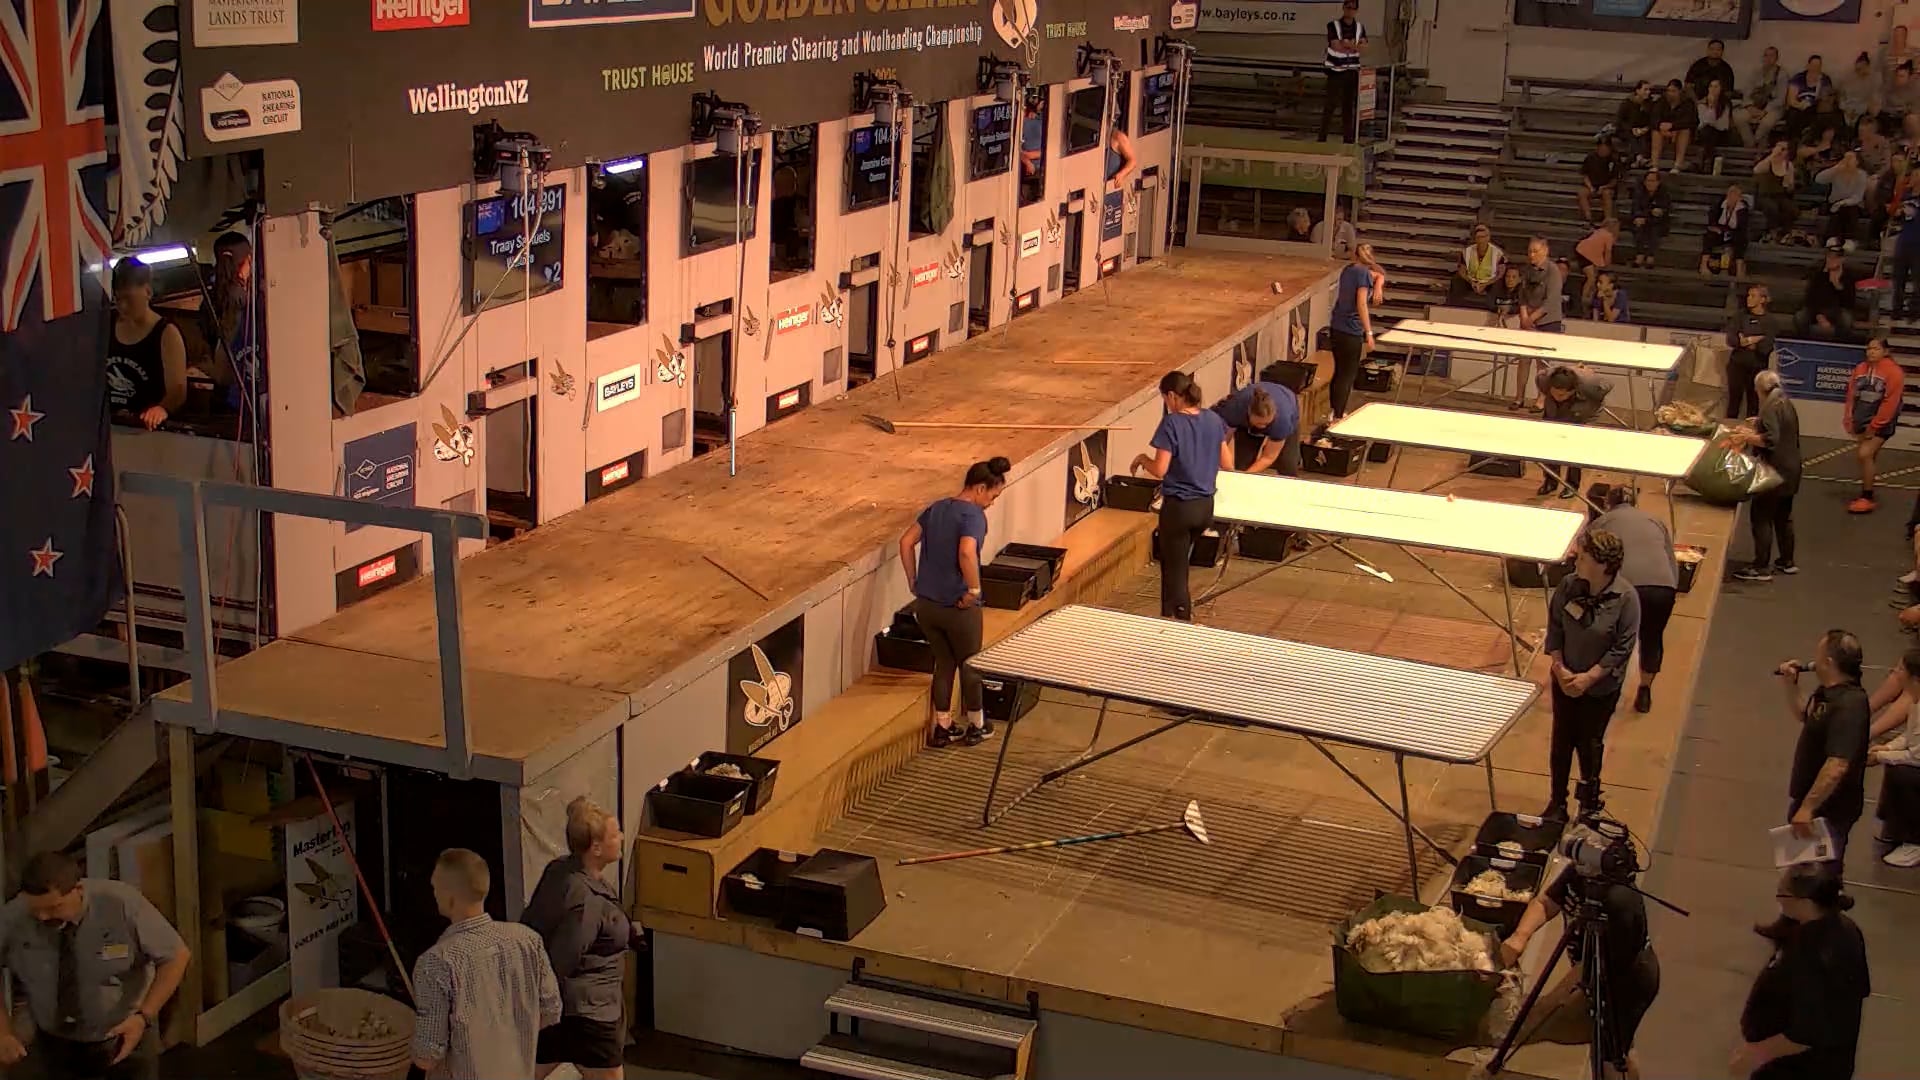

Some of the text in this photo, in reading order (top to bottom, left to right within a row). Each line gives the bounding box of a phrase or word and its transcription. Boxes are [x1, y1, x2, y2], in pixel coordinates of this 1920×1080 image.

[209, 9, 285, 26] LANDS TRUST
[1200, 8, 1297, 22] w.bayleys.co.nz
[703, 21, 982, 72] World Premier Shearing and Woolhandling Championship
[602, 62, 695, 91] TRUST HOUSE
[261, 88, 295, 101] NATIONAL
[408, 79, 529, 115] WellingtonNZ
[262, 101, 296, 113] SHEARING
[262, 113, 288, 125] CIRCUIT
[552, 261, 561, 282] 2
[778, 311, 809, 330] Heiniger
[1816, 366, 1852, 375] NATIONA
[603, 378, 635, 398] BAYLEYS
[1815, 381, 1846, 391] CIRCUIT
